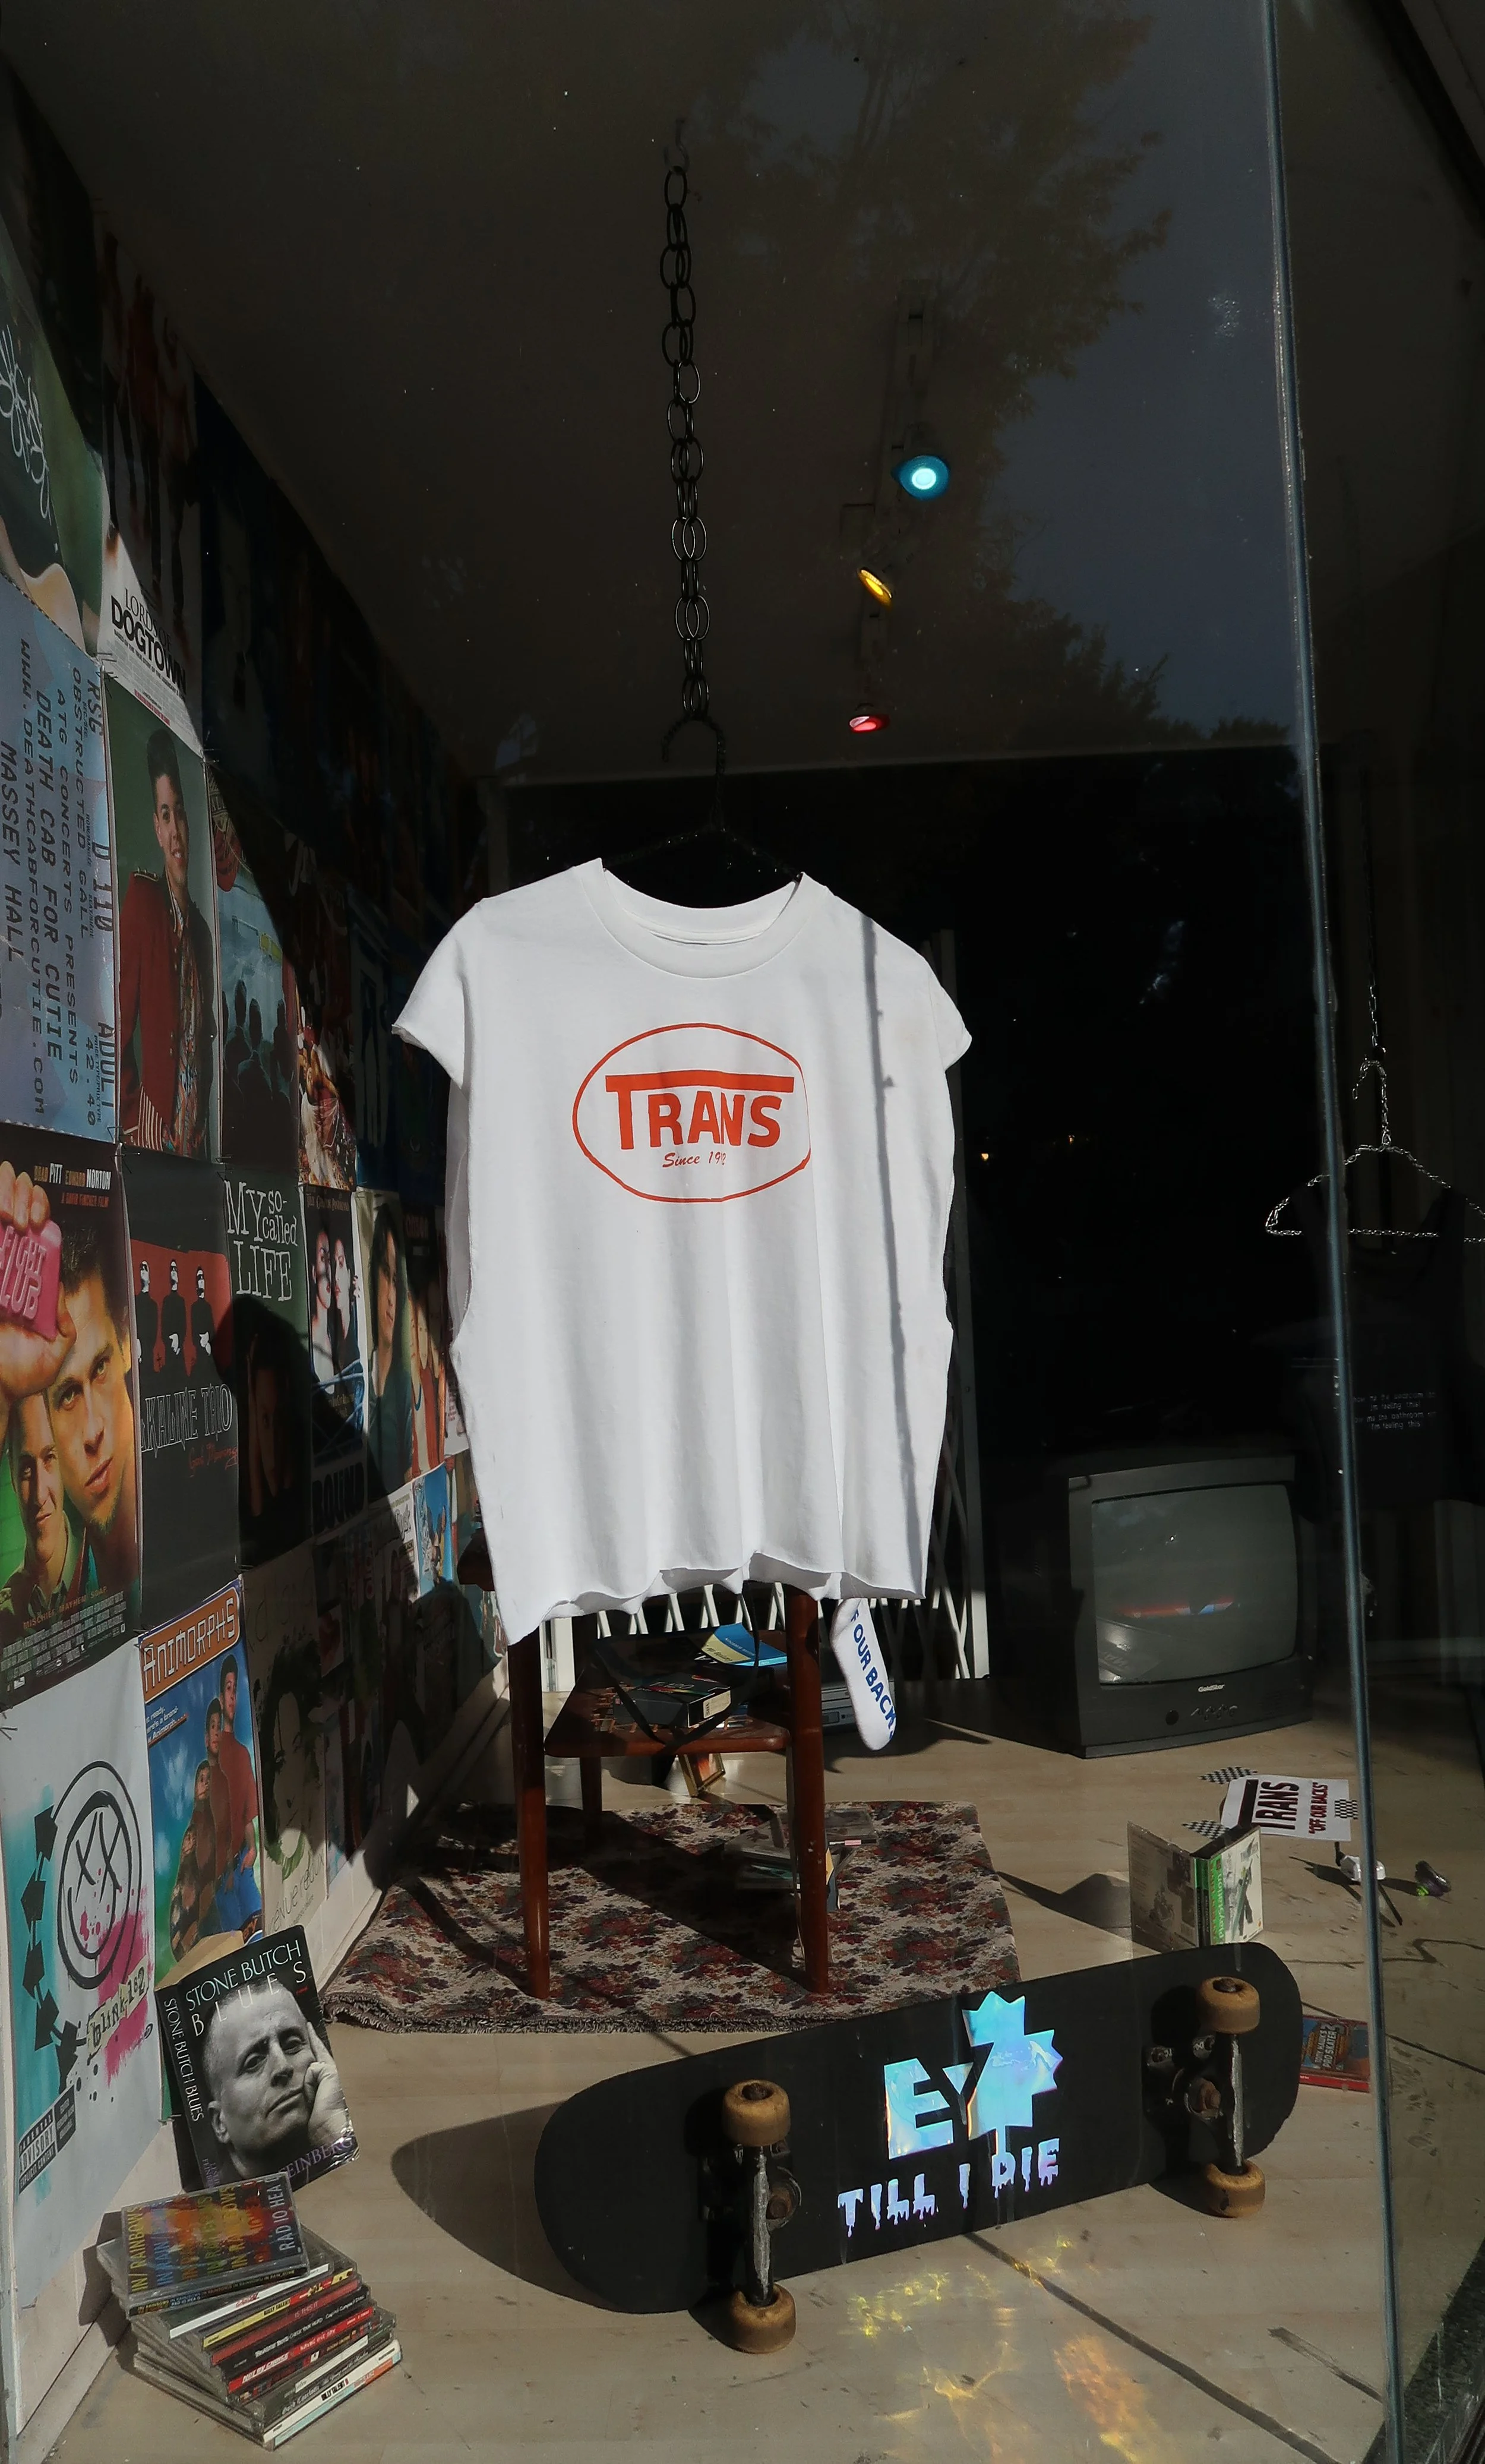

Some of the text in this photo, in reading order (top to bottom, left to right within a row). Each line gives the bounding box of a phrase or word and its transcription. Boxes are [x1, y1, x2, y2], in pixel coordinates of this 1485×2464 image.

[111, 595, 187, 695] DOGTOWN
[125, 587, 172, 652] LORDS OF
[72, 667, 88, 939] OBSTRUCTED GALL
[1, 741, 24, 962] MASSEY HALL
[36, 690, 62, 1061] DEATH CAB FOR CUTIE
[57, 688, 78, 1085] ATG CONCERTS PRESENTS
[605, 1069, 795, 1151] TRANS
[34, 1165, 49, 1183] BRAD
[49, 1162, 63, 1184] PITT
[86, 1168, 112, 1190] NORTON
[662, 1151, 701, 1168] Since
[262, 1215, 298, 1247] called
[269, 1190, 287, 1215] so-
[0, 1259, 42, 1320] LUB
[233, 1240, 292, 1302] LIFE
[200, 1383, 233, 1442] TRIO
[143, 1597, 236, 1692] ANIMORPHS
[854, 1623, 871, 1671] OUR
[185, 1939, 301, 2011] STONE BUTCH
[192, 1960, 307, 2037] BLUES
[164, 1998, 205, 2123] STONE BUTCH BLUES
[1322, 2054, 1334, 2068] PRO
[1325, 2029, 1338, 2055] SKATER
[19, 2114, 52, 2152] PARENTAL
[19, 2125, 53, 2173] ADVISORY
[838, 2138, 1061, 2238] TILL I DIE
[127, 2206, 147, 2270] RAINBOWS
[274, 2225, 296, 2252] RAD
[264, 2304, 276, 2316] BILLY
[275, 2298, 290, 2311] TALENT
[301, 2304, 313, 2315] THIS
[266, 2352, 290, 2370] CHOICE
[321, 2390, 332, 2402] BILLY
[331, 2380, 346, 2394] TALENT
